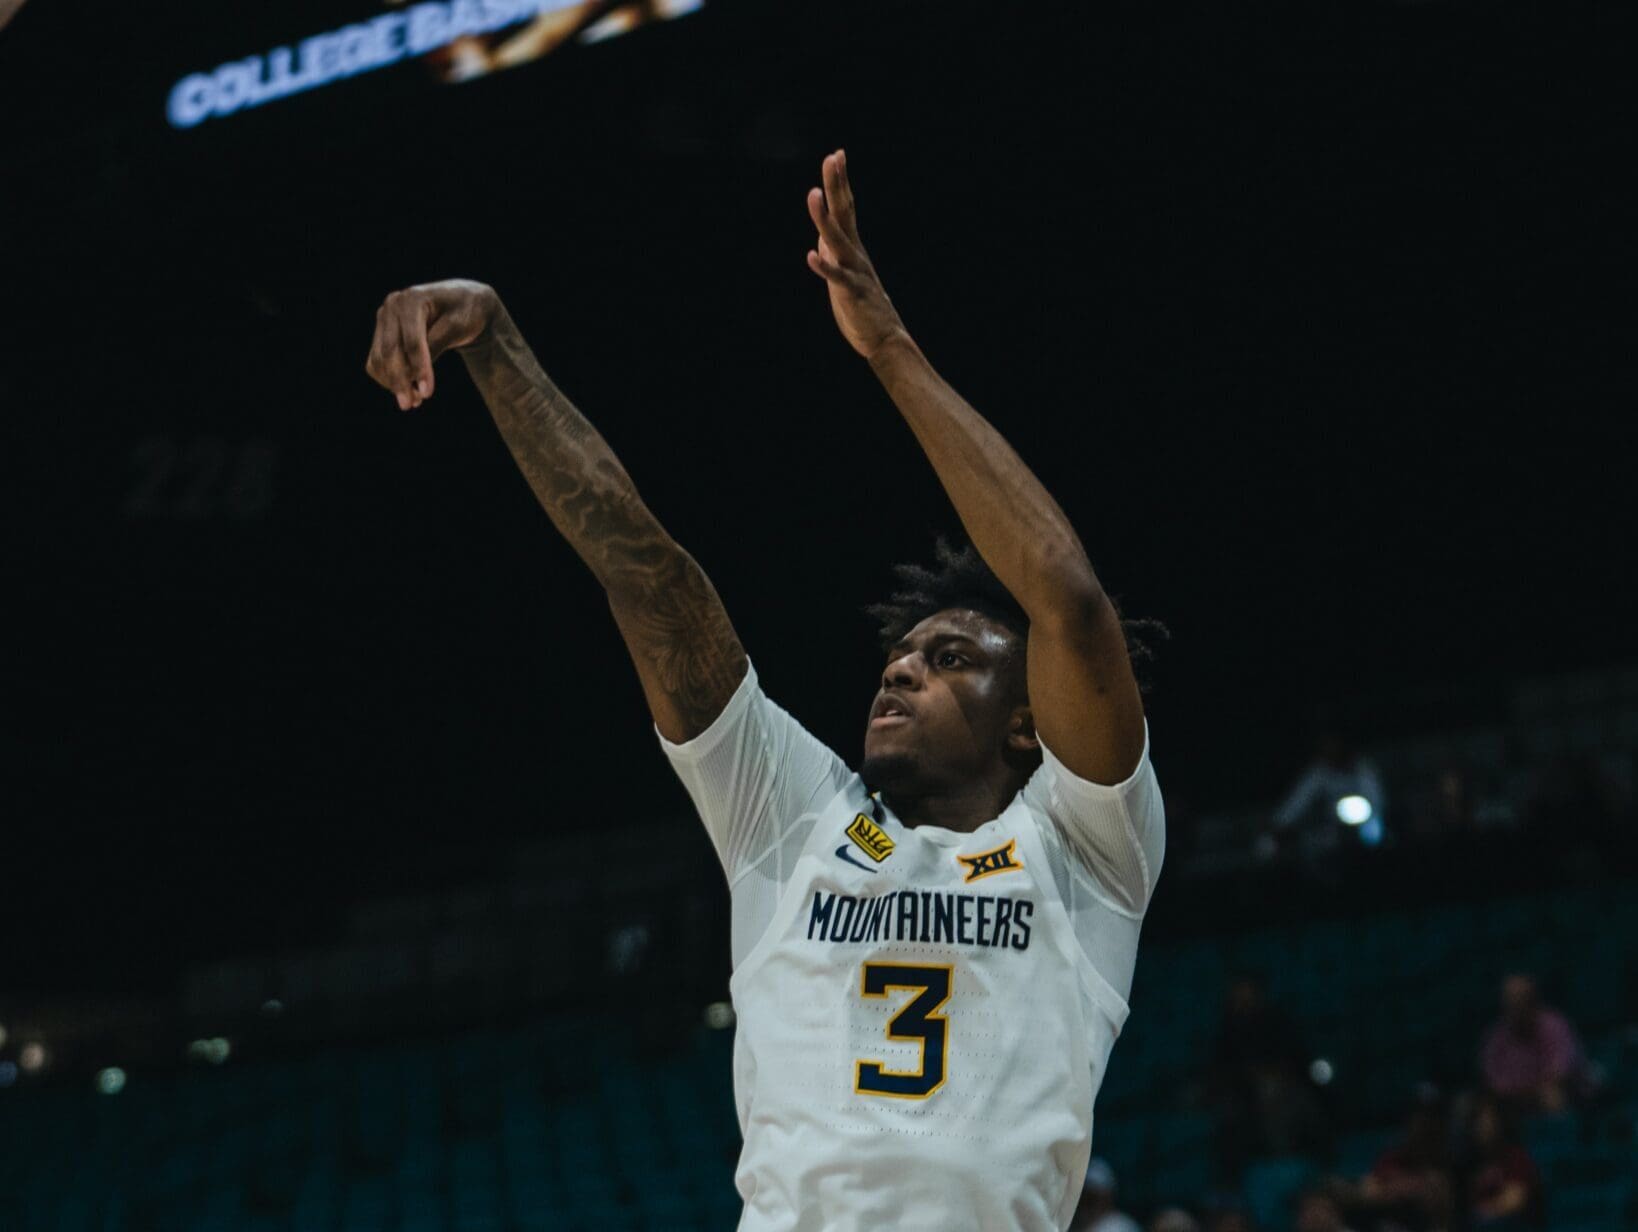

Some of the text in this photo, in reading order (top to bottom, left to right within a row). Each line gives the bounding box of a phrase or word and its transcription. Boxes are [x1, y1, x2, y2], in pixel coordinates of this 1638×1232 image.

[166, 12, 406, 128] COLLEGE
[959, 842, 1022, 882] XII
[807, 890, 1034, 951] MOUNTAINEERS
[854, 960, 954, 1100] 3
